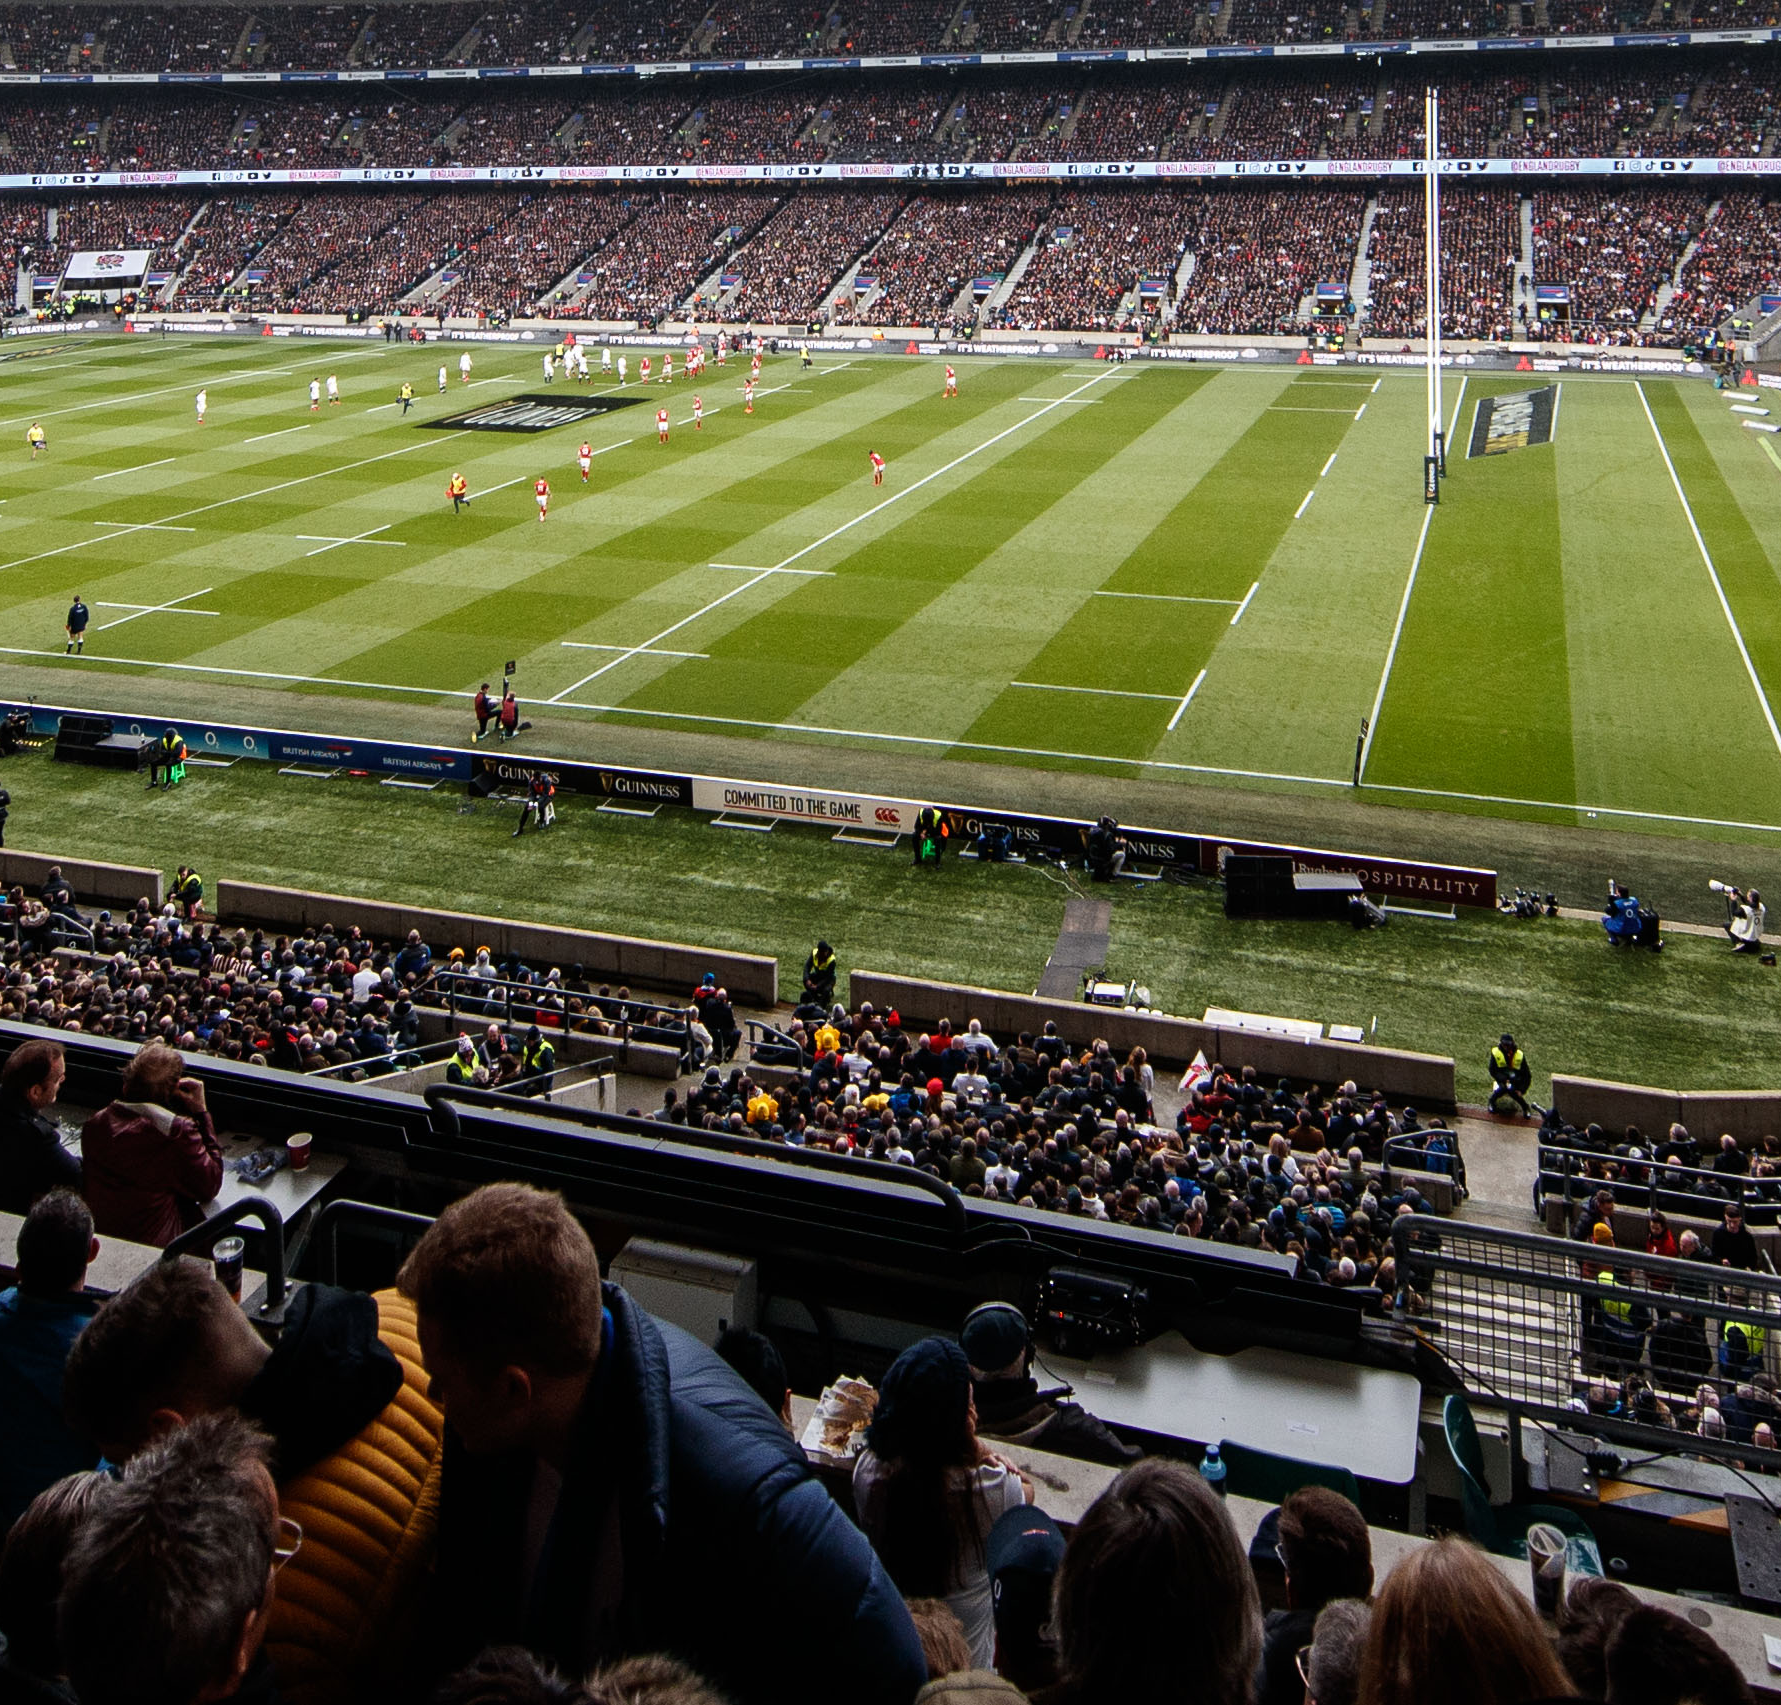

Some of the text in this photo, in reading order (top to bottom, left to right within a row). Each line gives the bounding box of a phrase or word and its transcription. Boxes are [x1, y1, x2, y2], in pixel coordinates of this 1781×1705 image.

[1155, 162, 1216, 174] @ENGLANDRUGBY
[1327, 162, 1393, 174] @ENGLANDRUGBY
[1511, 160, 1580, 172] @ENGLANDRUGBY
[120, 173, 177, 184] @ENGLANDRUGBY
[958, 343, 1040, 354] IT'S WEATHERPROOF
[1150, 348, 1238, 359] IT'S WEATHERPROOF
[1581, 359, 1684, 373] IT'S WEATHERPROOF
[282, 745, 340, 760] BRITISH AIRWAYS
[383, 756, 442, 772] BRITISH AIRWAYS
[615, 777, 680, 799] GUINNESS
[724, 789, 861, 819] COMMITTED TO THE GAME
